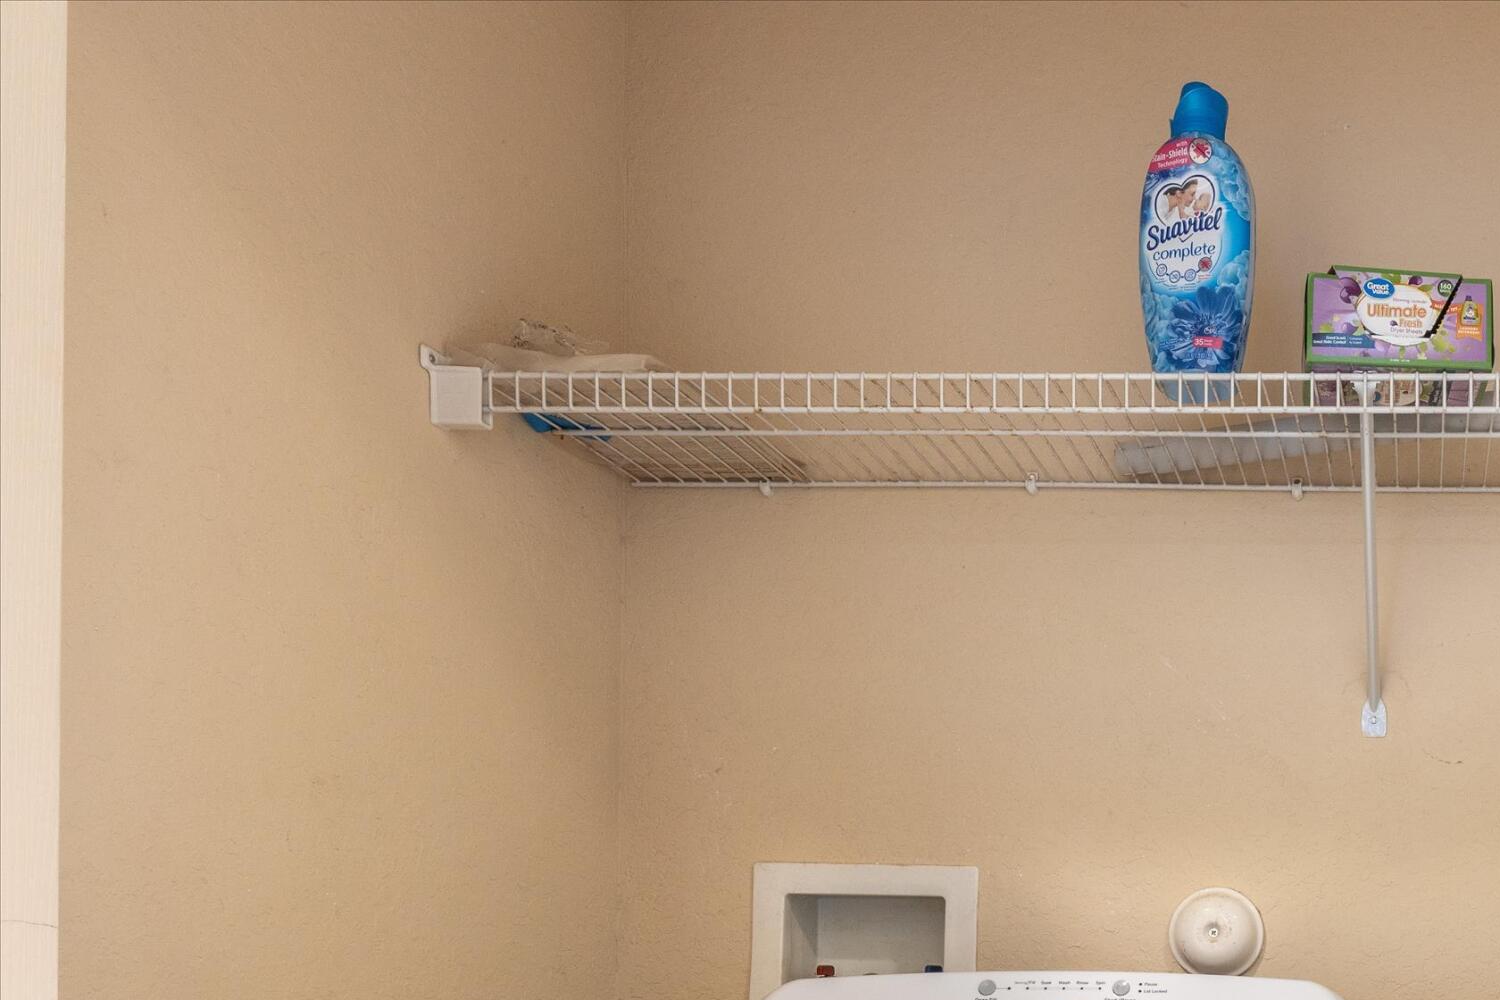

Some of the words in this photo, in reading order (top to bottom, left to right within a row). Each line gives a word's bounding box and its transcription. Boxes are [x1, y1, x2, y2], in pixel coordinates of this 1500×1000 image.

[1146, 207, 1222, 251] Suavitel
[1153, 242, 1216, 262] complete
[1367, 282, 1390, 291] Great
[1367, 303, 1427, 318] Ultimate
[1400, 319, 1422, 328] Fresh
